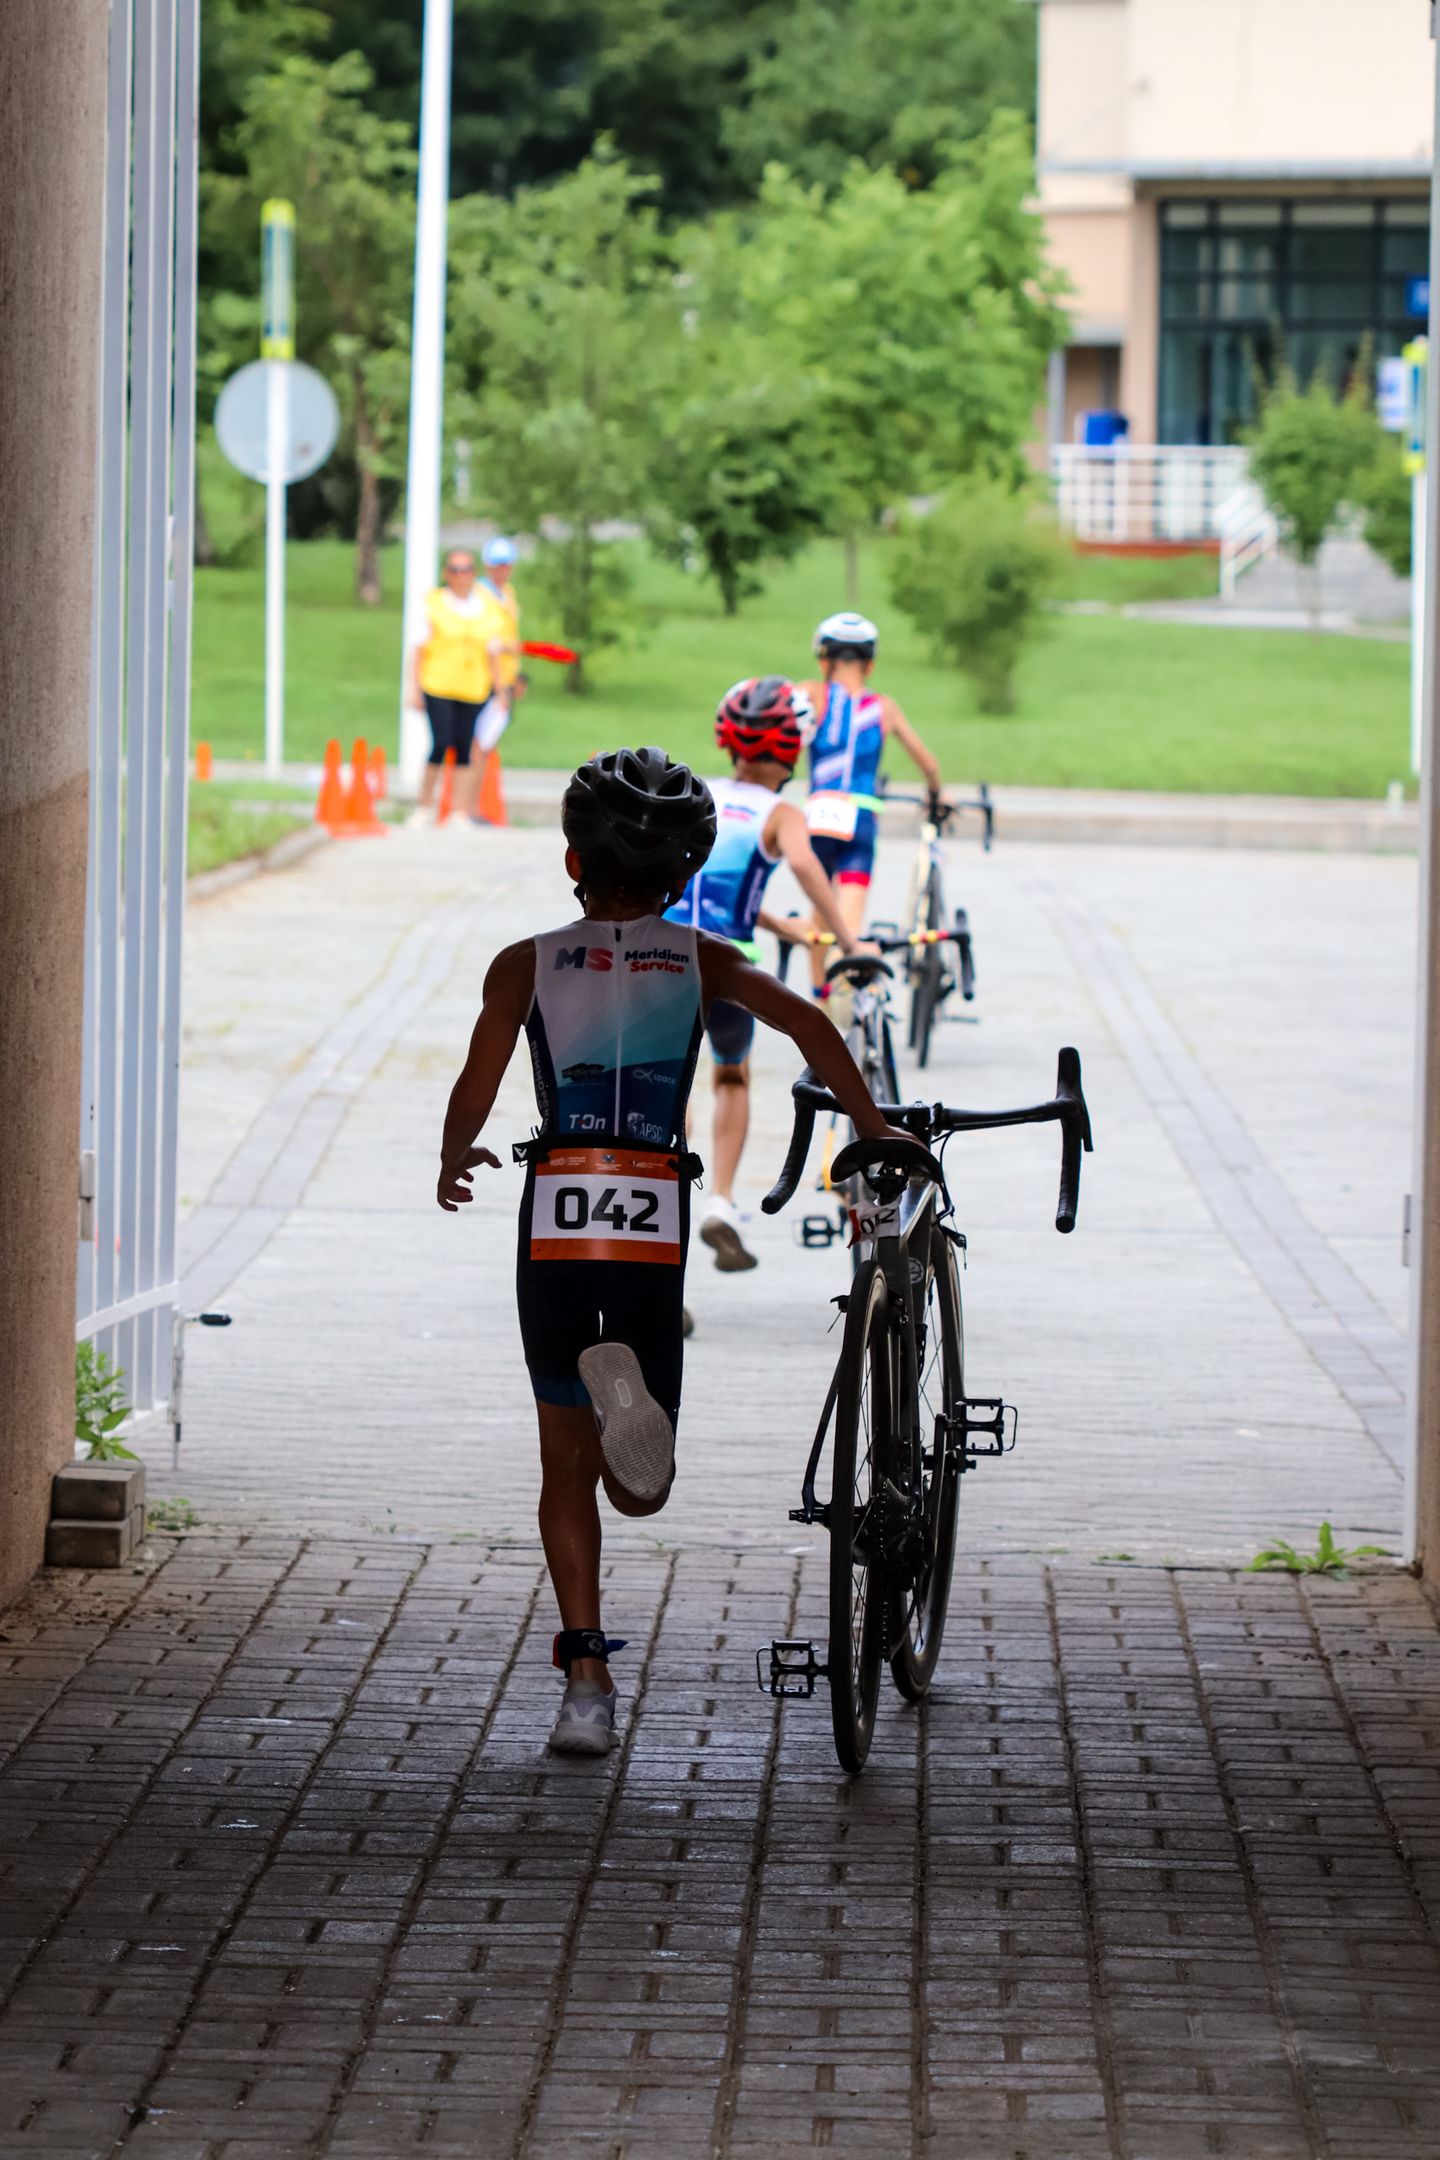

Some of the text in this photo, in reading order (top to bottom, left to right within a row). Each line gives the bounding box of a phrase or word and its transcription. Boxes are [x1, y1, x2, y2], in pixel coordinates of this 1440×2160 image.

[554, 946, 614, 972] MS
[624, 948, 690, 963] Meridian
[630, 961, 685, 974] Service
[640, 1122, 663, 1141] APSC
[554, 1187, 660, 1233] 042
